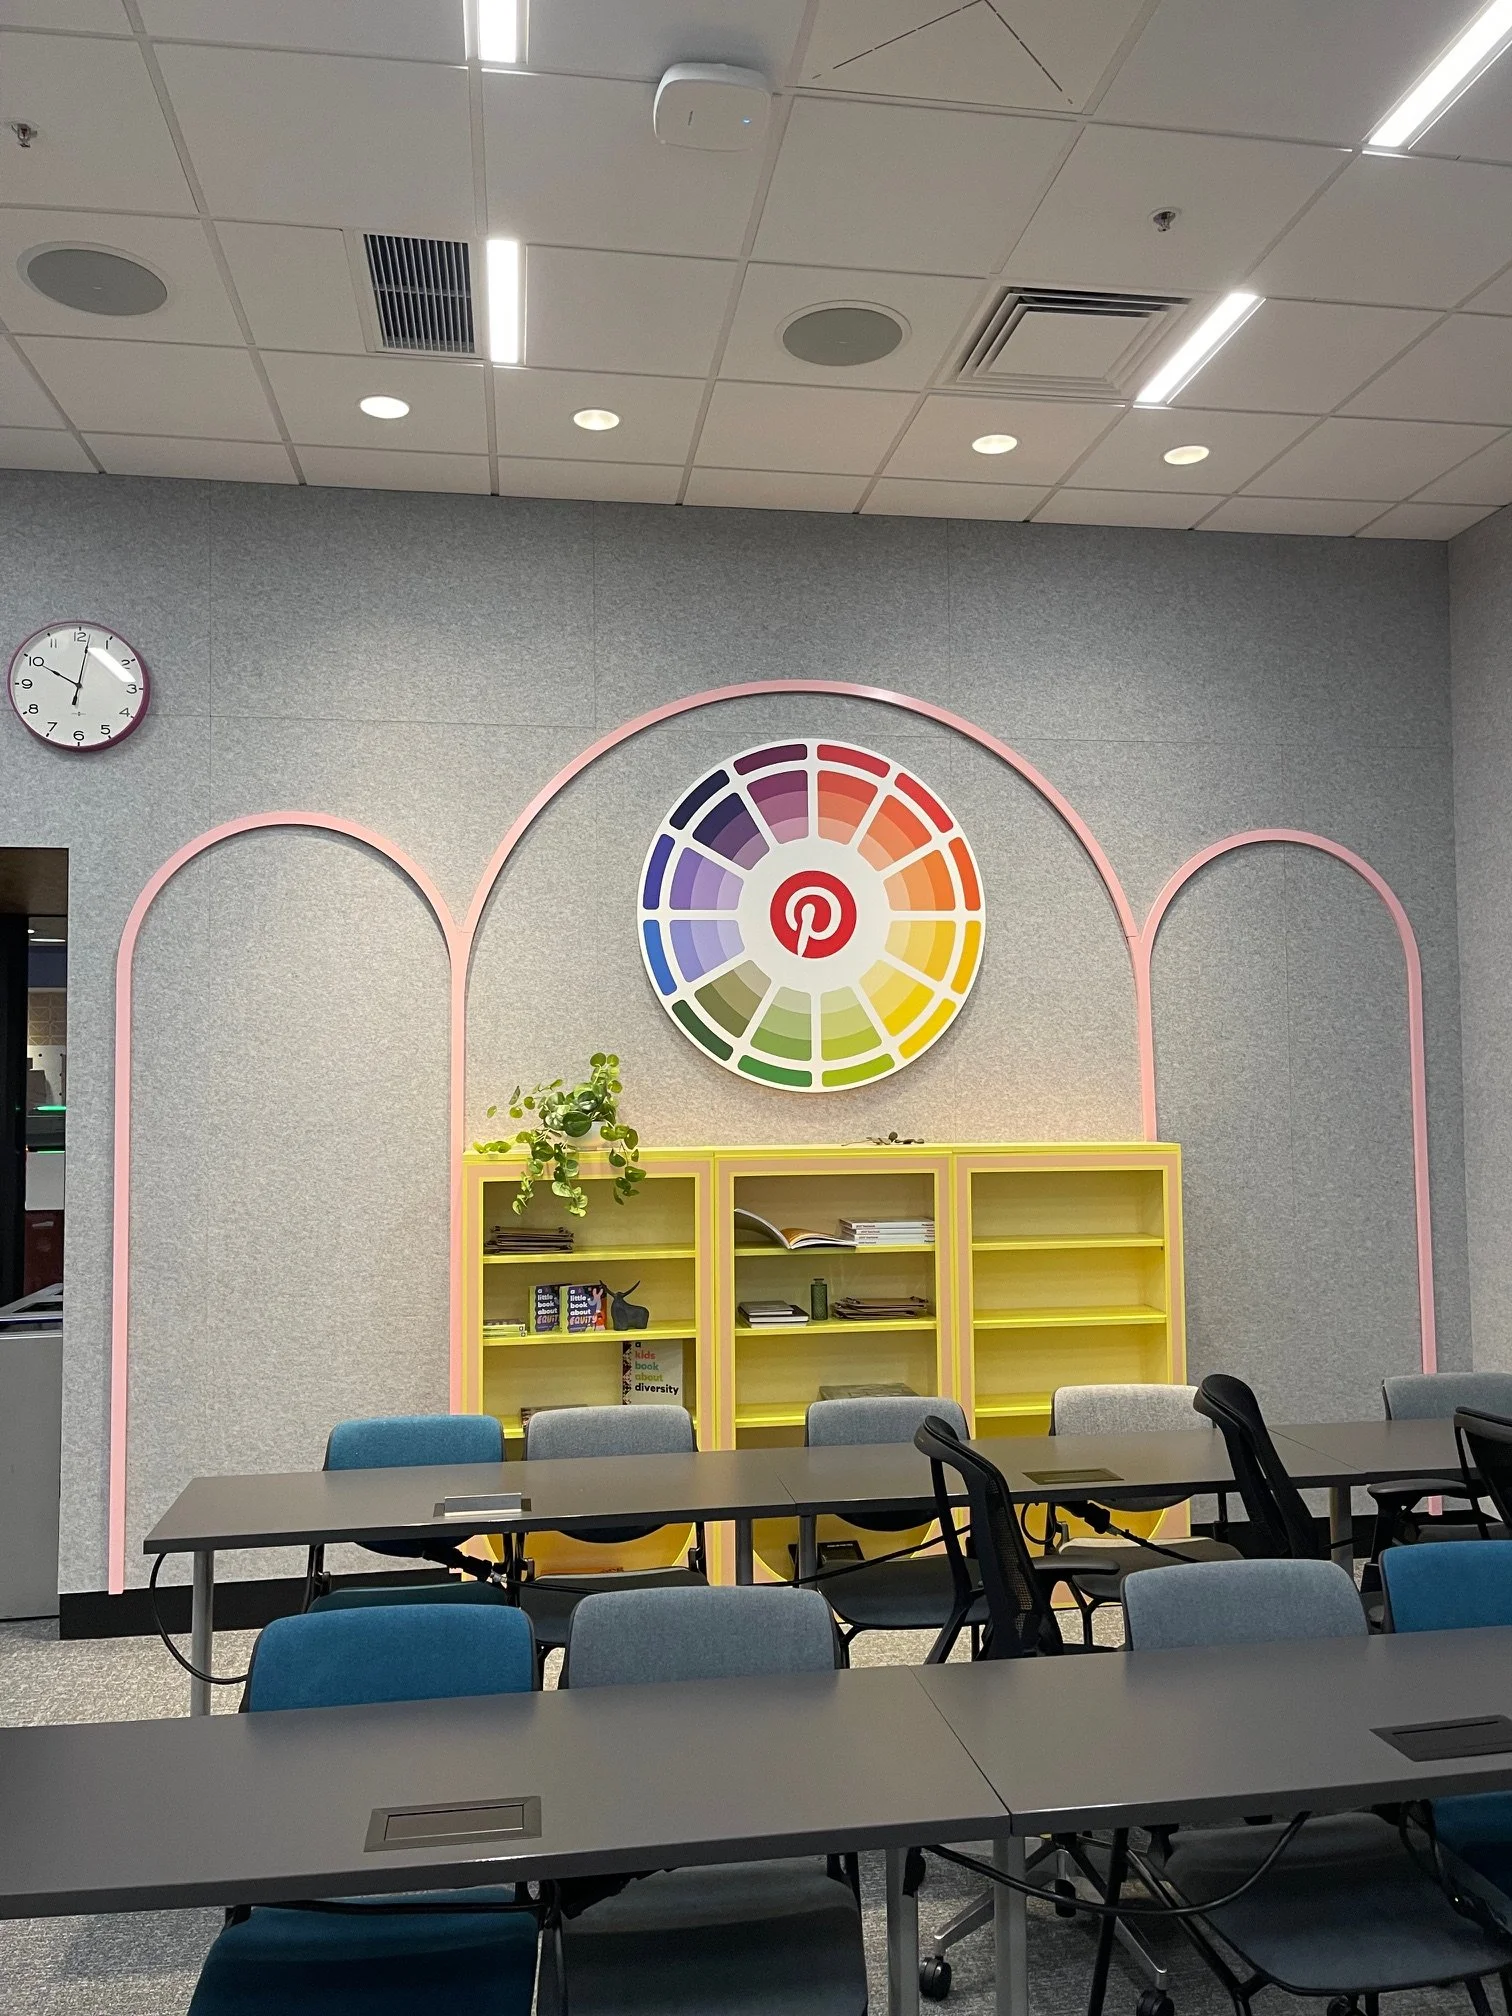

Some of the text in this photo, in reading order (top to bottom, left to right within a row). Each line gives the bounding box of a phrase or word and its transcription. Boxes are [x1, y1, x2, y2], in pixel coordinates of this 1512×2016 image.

[74, 632, 86, 642] 12
[50, 639, 57, 648] 11
[29, 656, 44, 666] 10
[122, 660, 130, 669] 2
[22, 679, 32, 689] 9
[127, 684, 137, 694] 3
[28, 704, 38, 714] 8
[119, 708, 130, 717] 4
[47, 722, 57, 732] 7
[101, 725, 110, 734] 5
[74, 731, 84, 740] 6
[635, 1350, 656, 1359] kids
[635, 1361, 659, 1370] book
[635, 1372, 663, 1382] about
[635, 1383, 679, 1395] diversity
